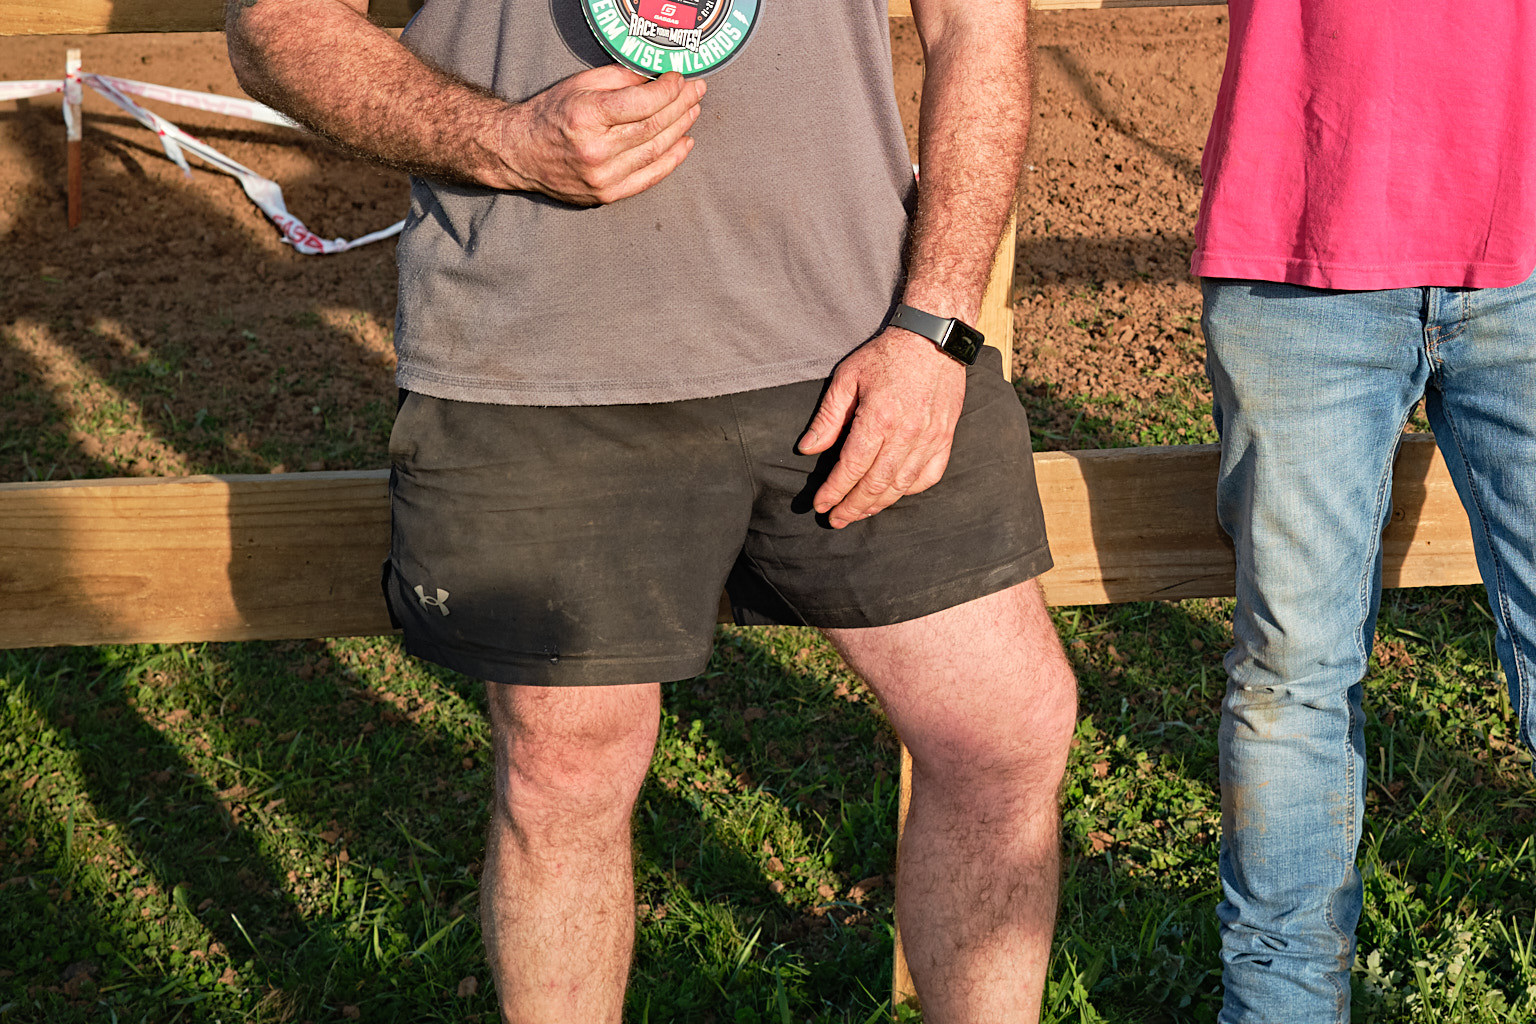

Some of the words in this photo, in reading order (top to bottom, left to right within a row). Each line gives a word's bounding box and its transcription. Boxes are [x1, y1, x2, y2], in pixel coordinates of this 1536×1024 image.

[620, 36, 665, 71] WISE
[670, 21, 742, 73] WIZARDS
[629, 13, 658, 37] RACE
[669, 28, 703, 53] MATES!
